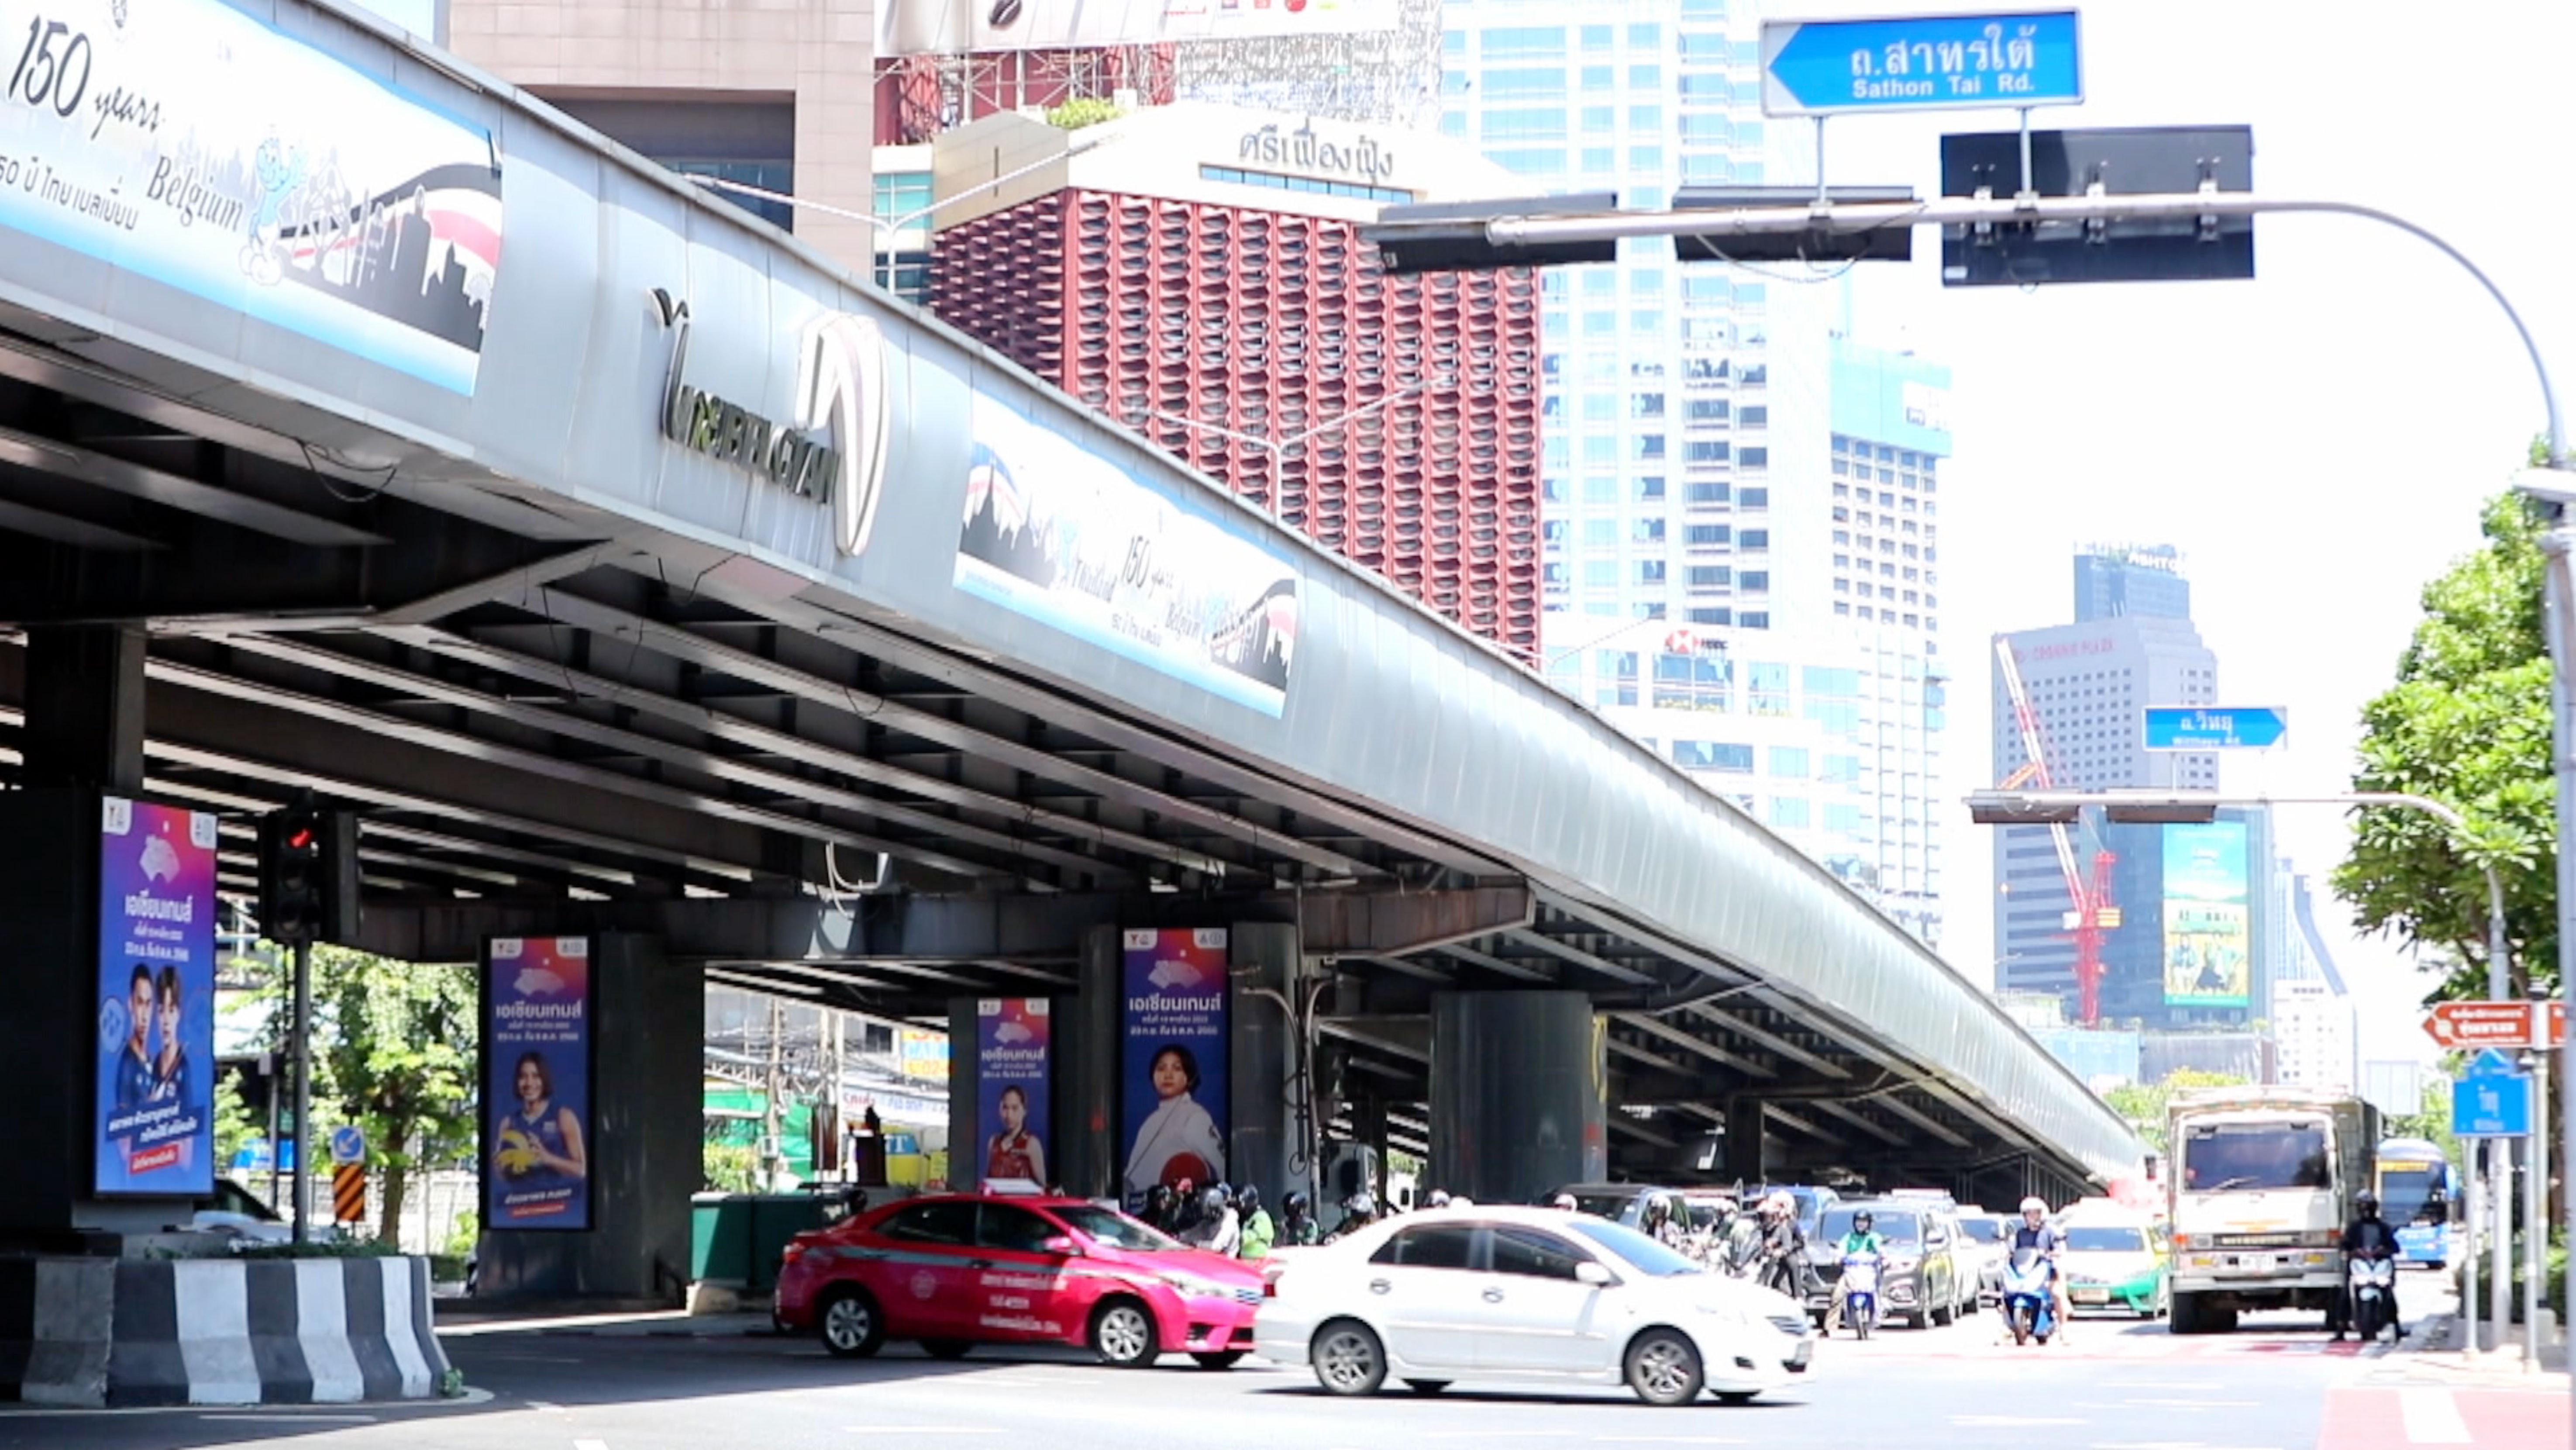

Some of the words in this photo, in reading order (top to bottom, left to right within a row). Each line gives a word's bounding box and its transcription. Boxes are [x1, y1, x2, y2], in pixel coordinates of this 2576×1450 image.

[8, 14, 91, 117] 150
[1851, 23, 2036, 75] ถ.สาทรใต้
[1853, 78, 1933, 98] Sathon
[1947, 74, 1981, 94] Tai
[1997, 72, 2035, 93] Rd.
[146, 155, 244, 232] Belgium
[496, 999, 582, 1018] เอเชียนเกมส์
[1129, 992, 1221, 1012] เอเชียนเกมส์
